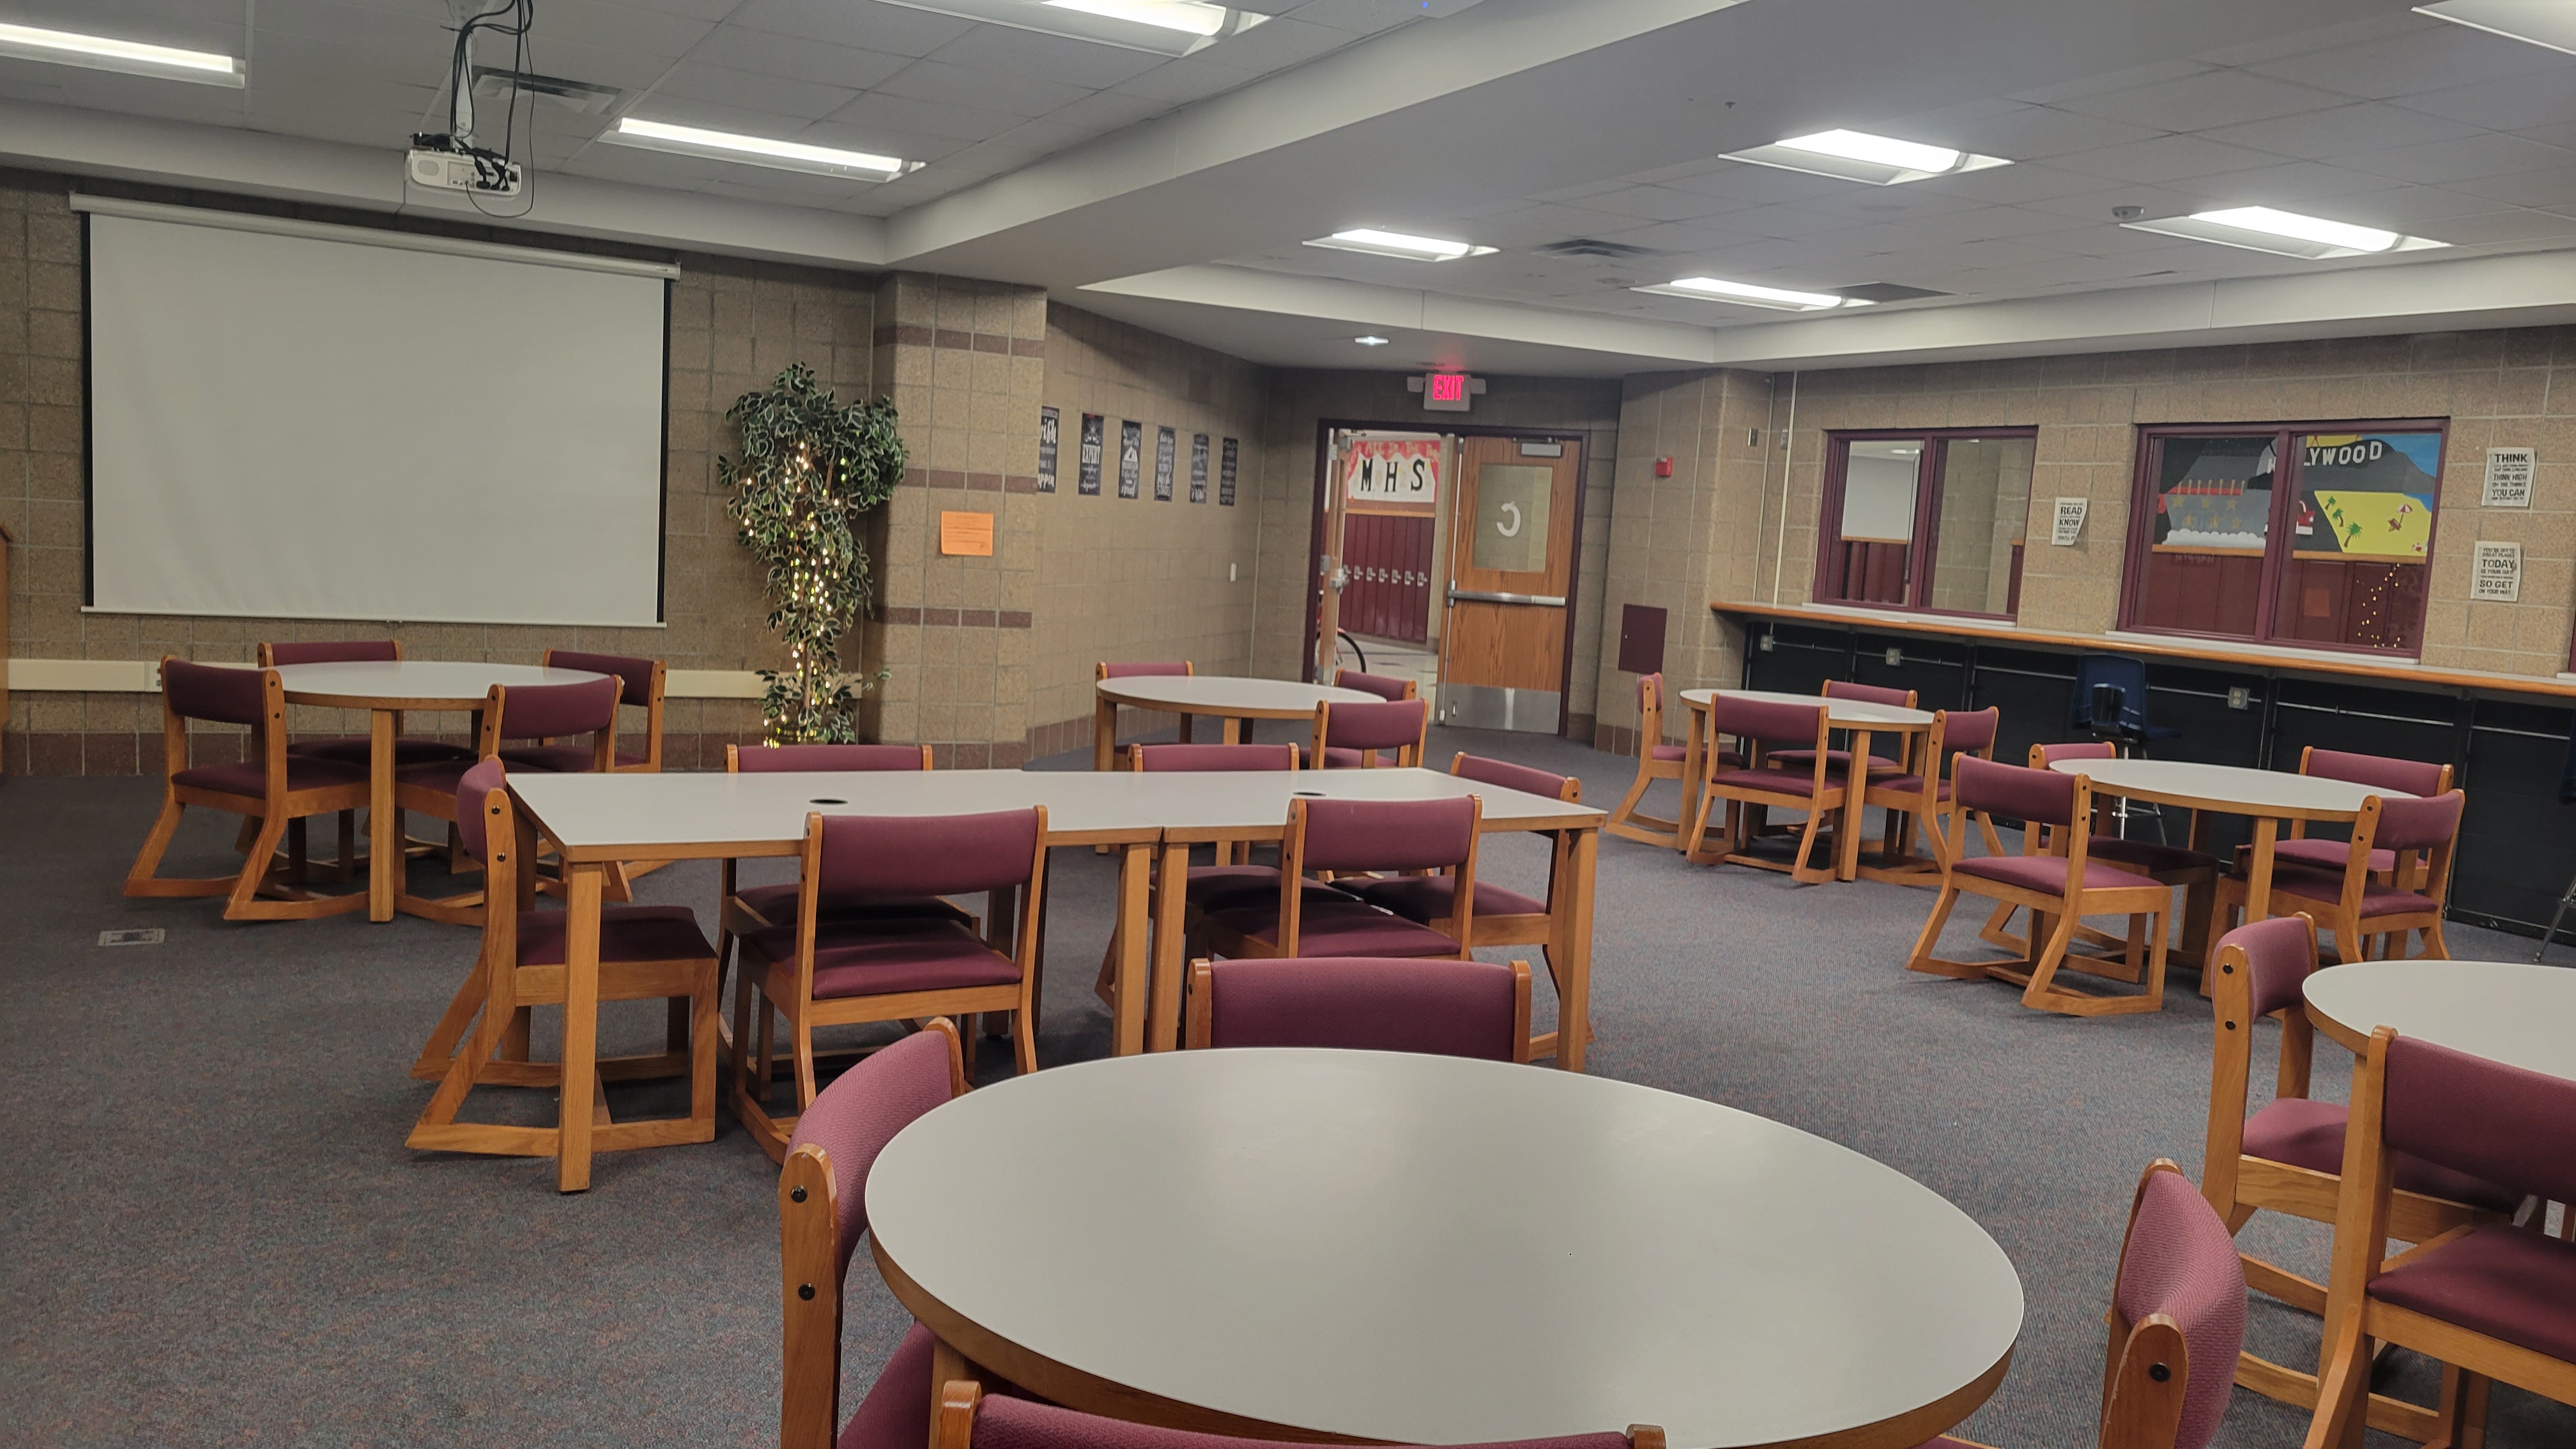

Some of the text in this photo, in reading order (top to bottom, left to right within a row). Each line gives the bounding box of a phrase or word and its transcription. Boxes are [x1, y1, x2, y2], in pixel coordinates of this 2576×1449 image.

[1433, 374, 1464, 401] EXIT
[1082, 444, 1101, 464] EXPERT
[2494, 453, 2528, 463] THINK
[2492, 489, 2526, 497] YOU CAN
[2060, 506, 2083, 516] READ
[2059, 518, 2080, 527] KNOW
[2481, 559, 2515, 569] TODAY
[2479, 579, 2514, 589] SO GET
